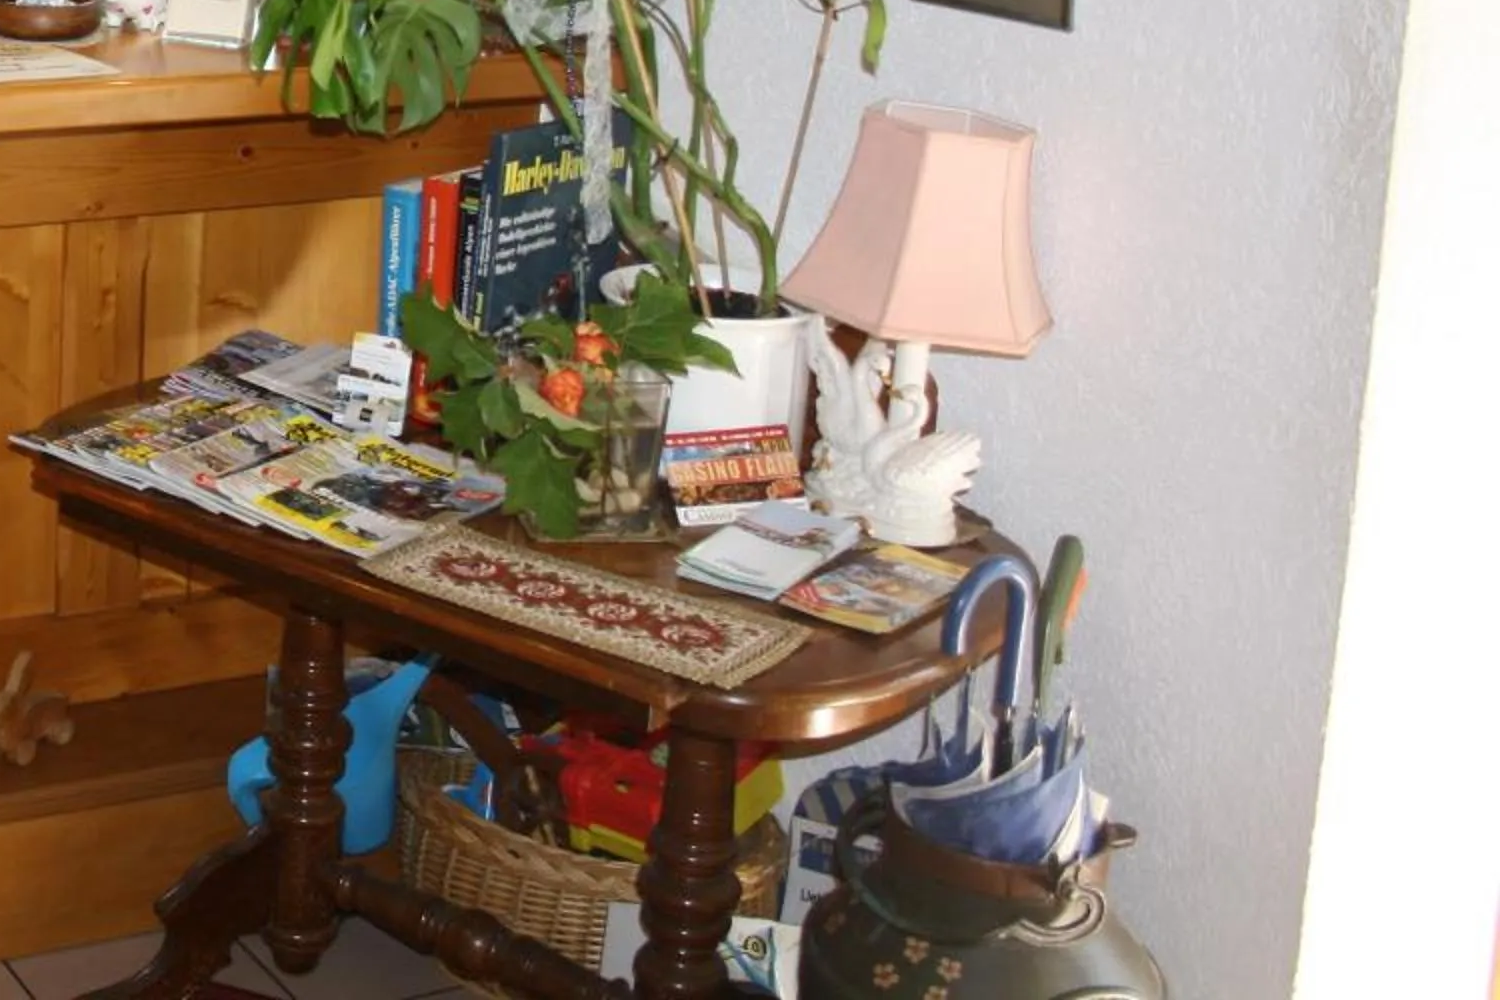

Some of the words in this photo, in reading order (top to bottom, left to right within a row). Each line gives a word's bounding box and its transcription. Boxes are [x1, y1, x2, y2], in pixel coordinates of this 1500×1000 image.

[503, 147, 626, 198] Harley-Davon
[386, 274, 398, 311] ADAC
[672, 458, 741, 484] CASINO
[746, 453, 797, 479] FLAIR
